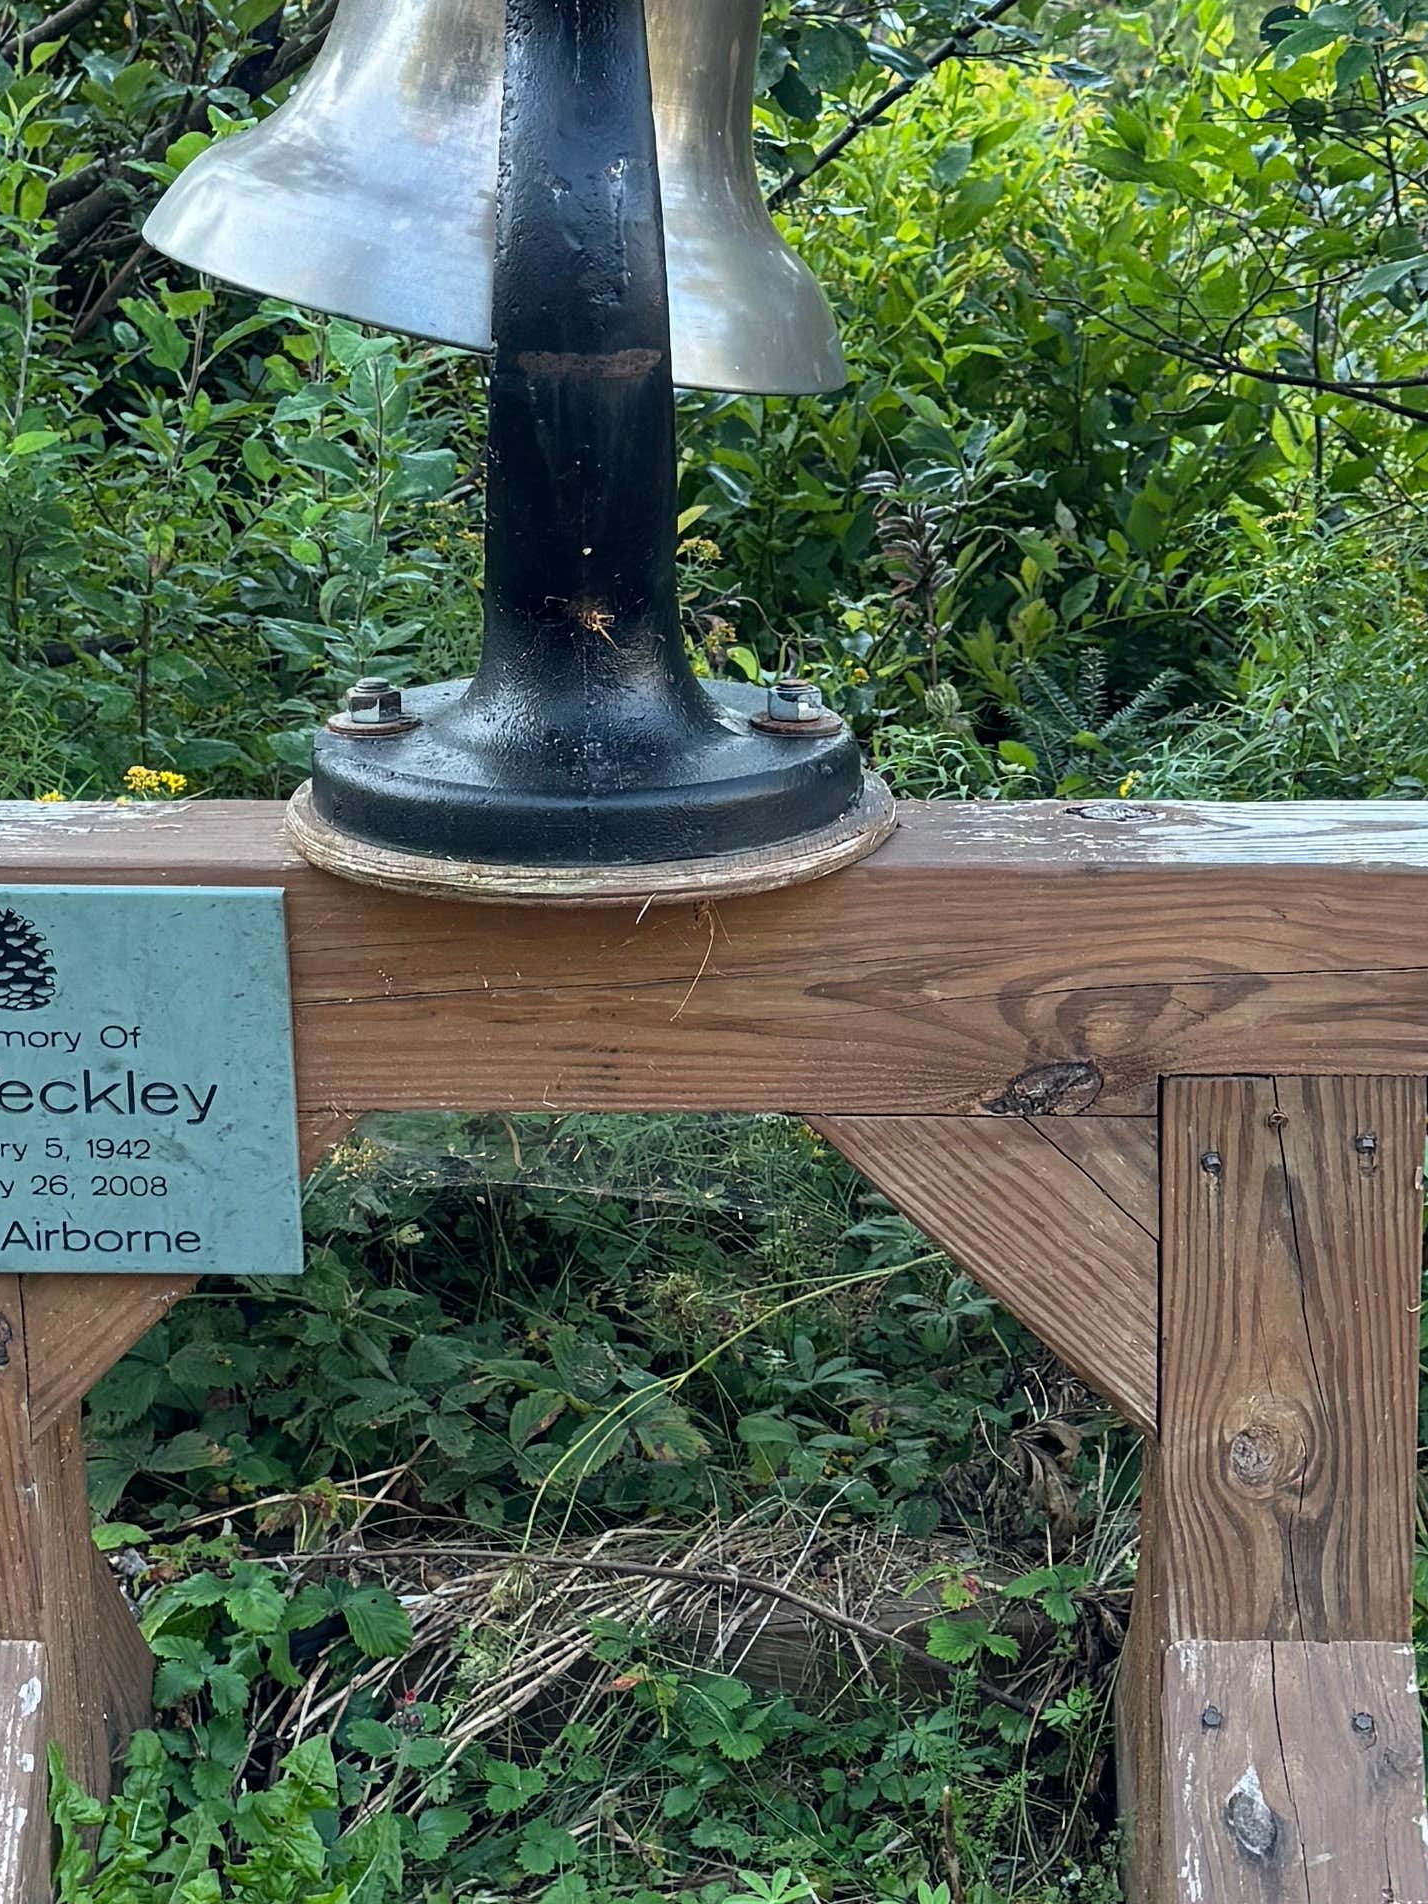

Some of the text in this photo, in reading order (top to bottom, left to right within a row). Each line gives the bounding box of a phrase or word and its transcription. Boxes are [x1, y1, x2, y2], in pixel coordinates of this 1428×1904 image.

[99, 1024, 141, 1049] Of
[44, 1138, 71, 1163] 5,
[86, 1138, 151, 1160] 1942
[30, 1174, 76, 1200] 26,
[91, 1176, 168, 1197] 2008
[0, 1221, 202, 1254] Airborne
